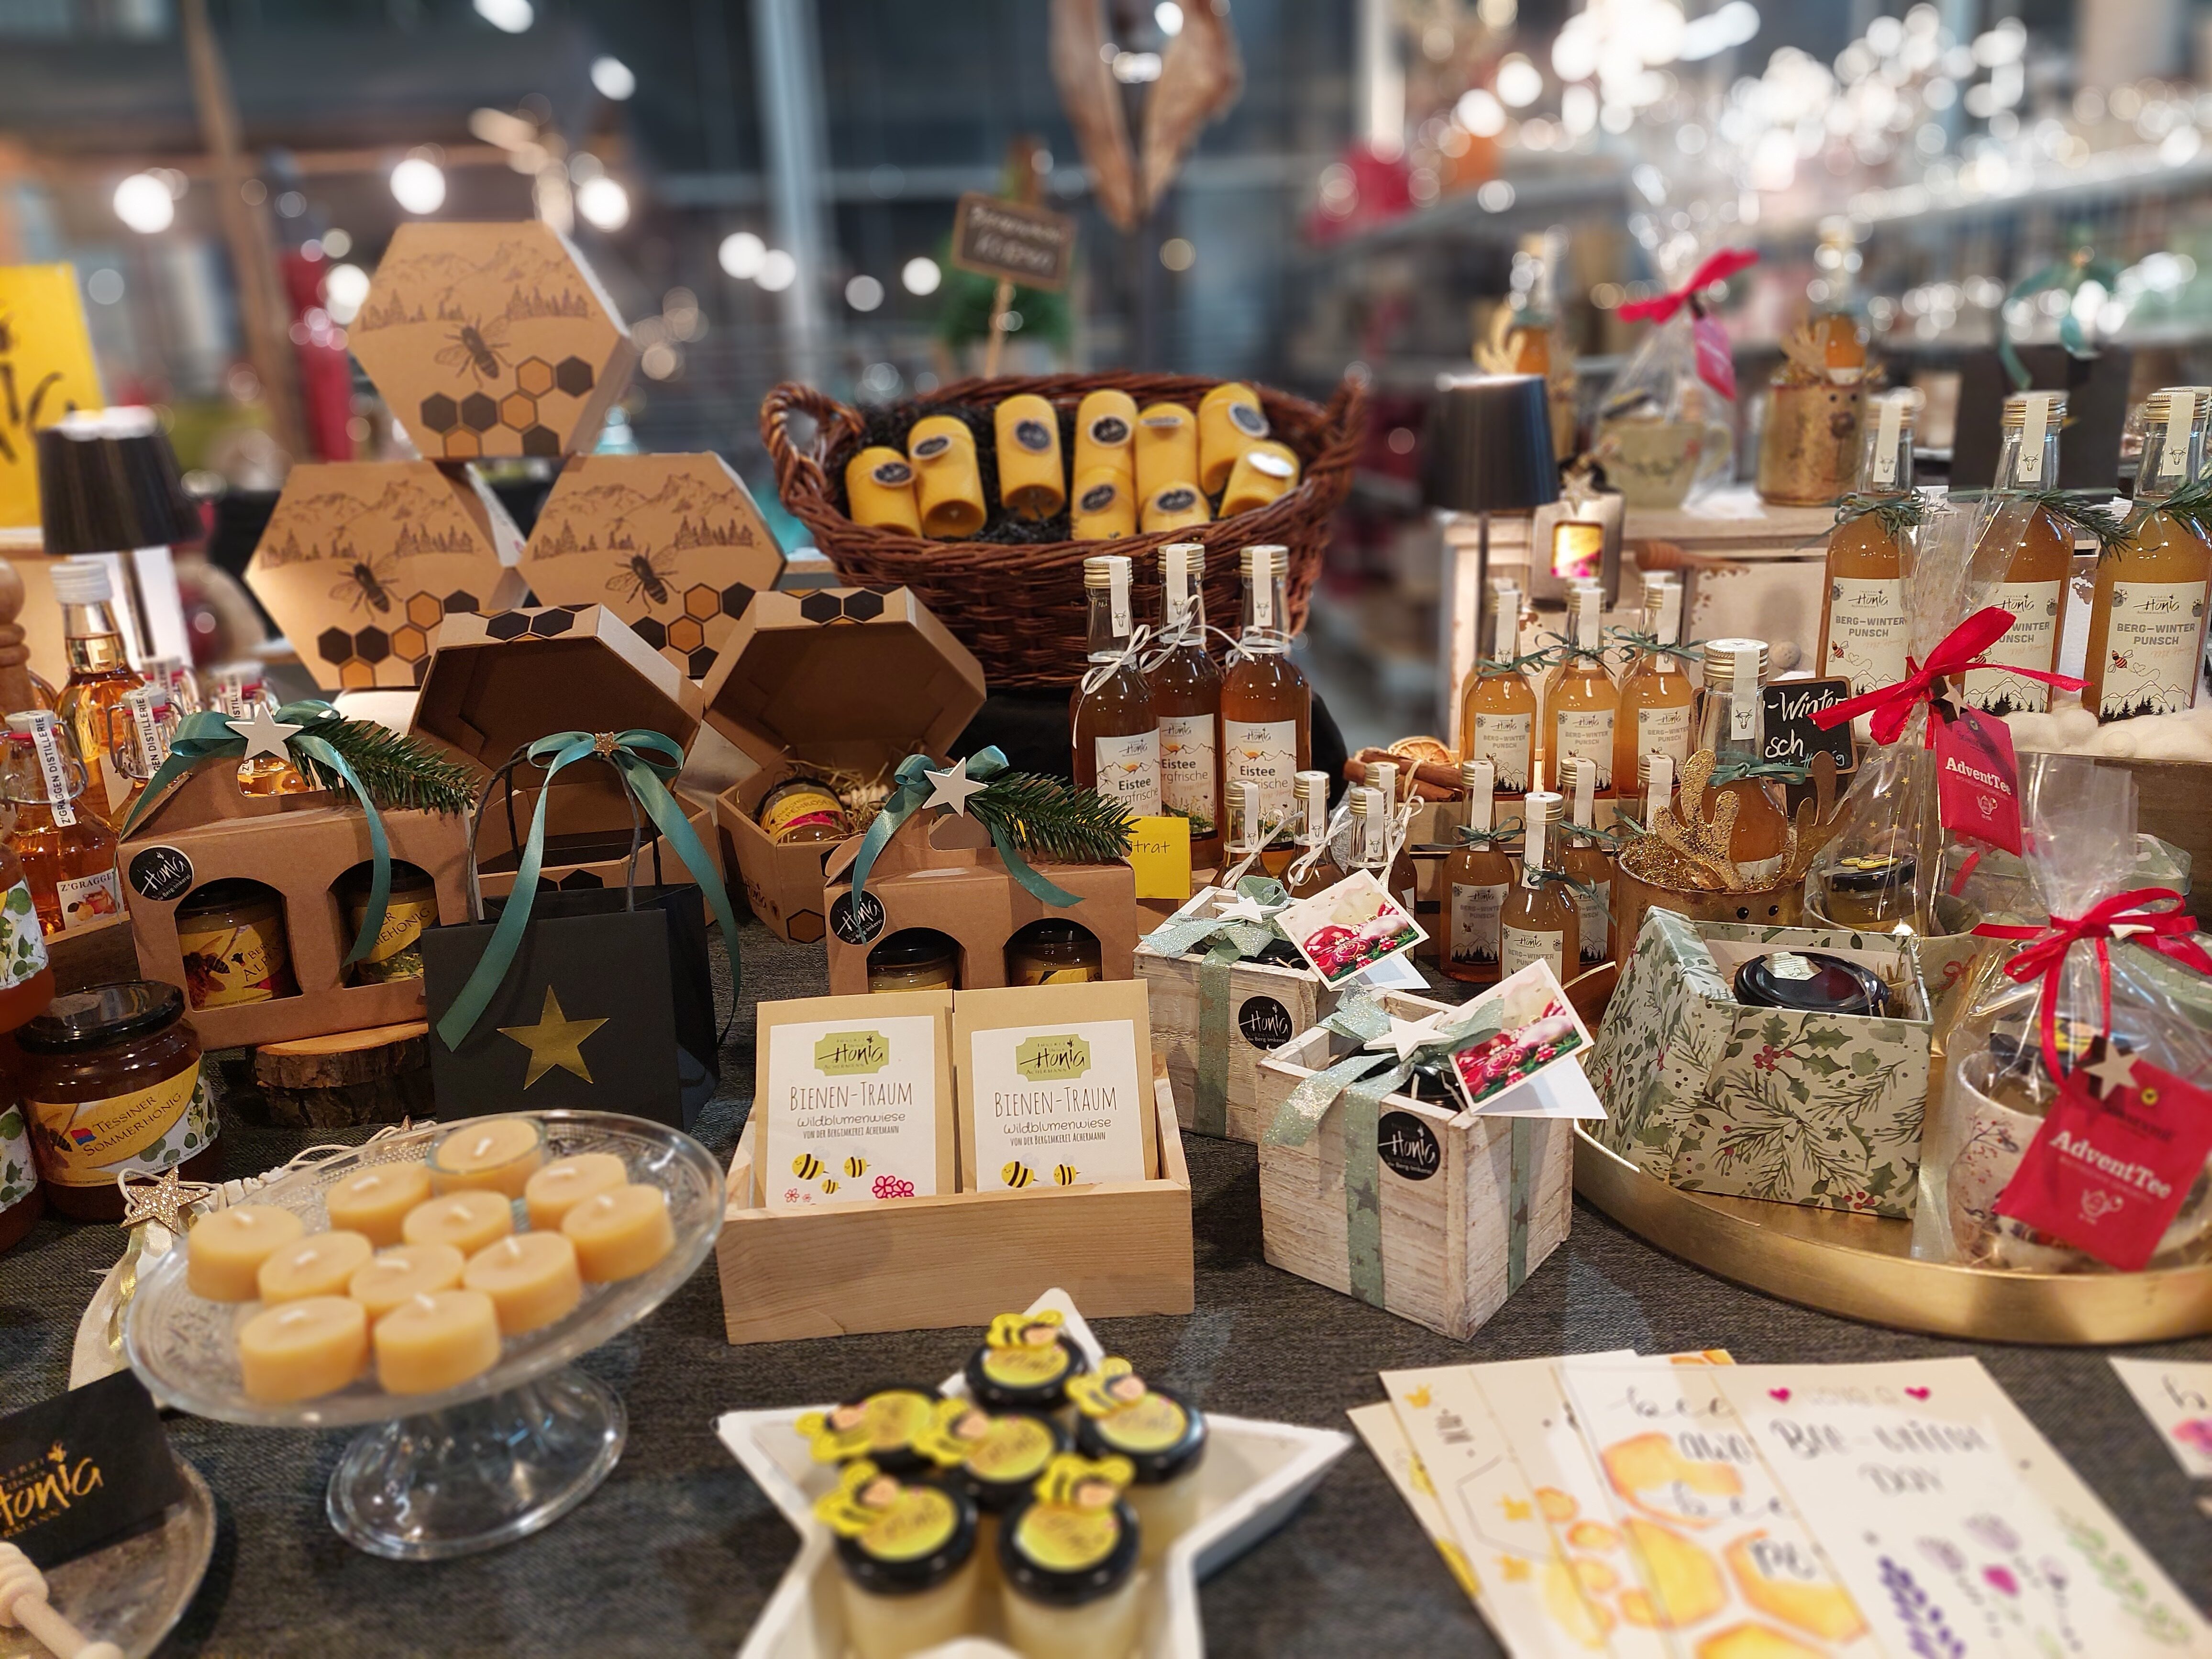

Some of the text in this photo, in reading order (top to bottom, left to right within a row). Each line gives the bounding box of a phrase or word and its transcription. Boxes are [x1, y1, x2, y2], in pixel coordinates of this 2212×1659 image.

[1848, 628, 1889, 637] PUNSCH
[1999, 634, 2035, 643] UNSCH
[2133, 636, 2179, 645] PUNSCH
[135, 697, 157, 752] DISTILLERIE
[35, 717, 72, 825] Z'GRAGGEN DISTILLERIE
[1161, 759, 1196, 769] Eistee
[1240, 765, 1276, 777] Eistee
[1945, 757, 2012, 796] AdventTee
[1106, 785, 1159, 806] Bergfrische
[1118, 777, 1151, 791] Eistee
[790, 1081, 912, 1111] BIENEN-TRAUM
[995, 1086, 1117, 1117] BIENEN-TRAUM
[83, 1092, 182, 1157] SOMMERHONIG
[93, 1095, 157, 1134] TESSINER
[2048, 1130, 2172, 1199] AdventTee
